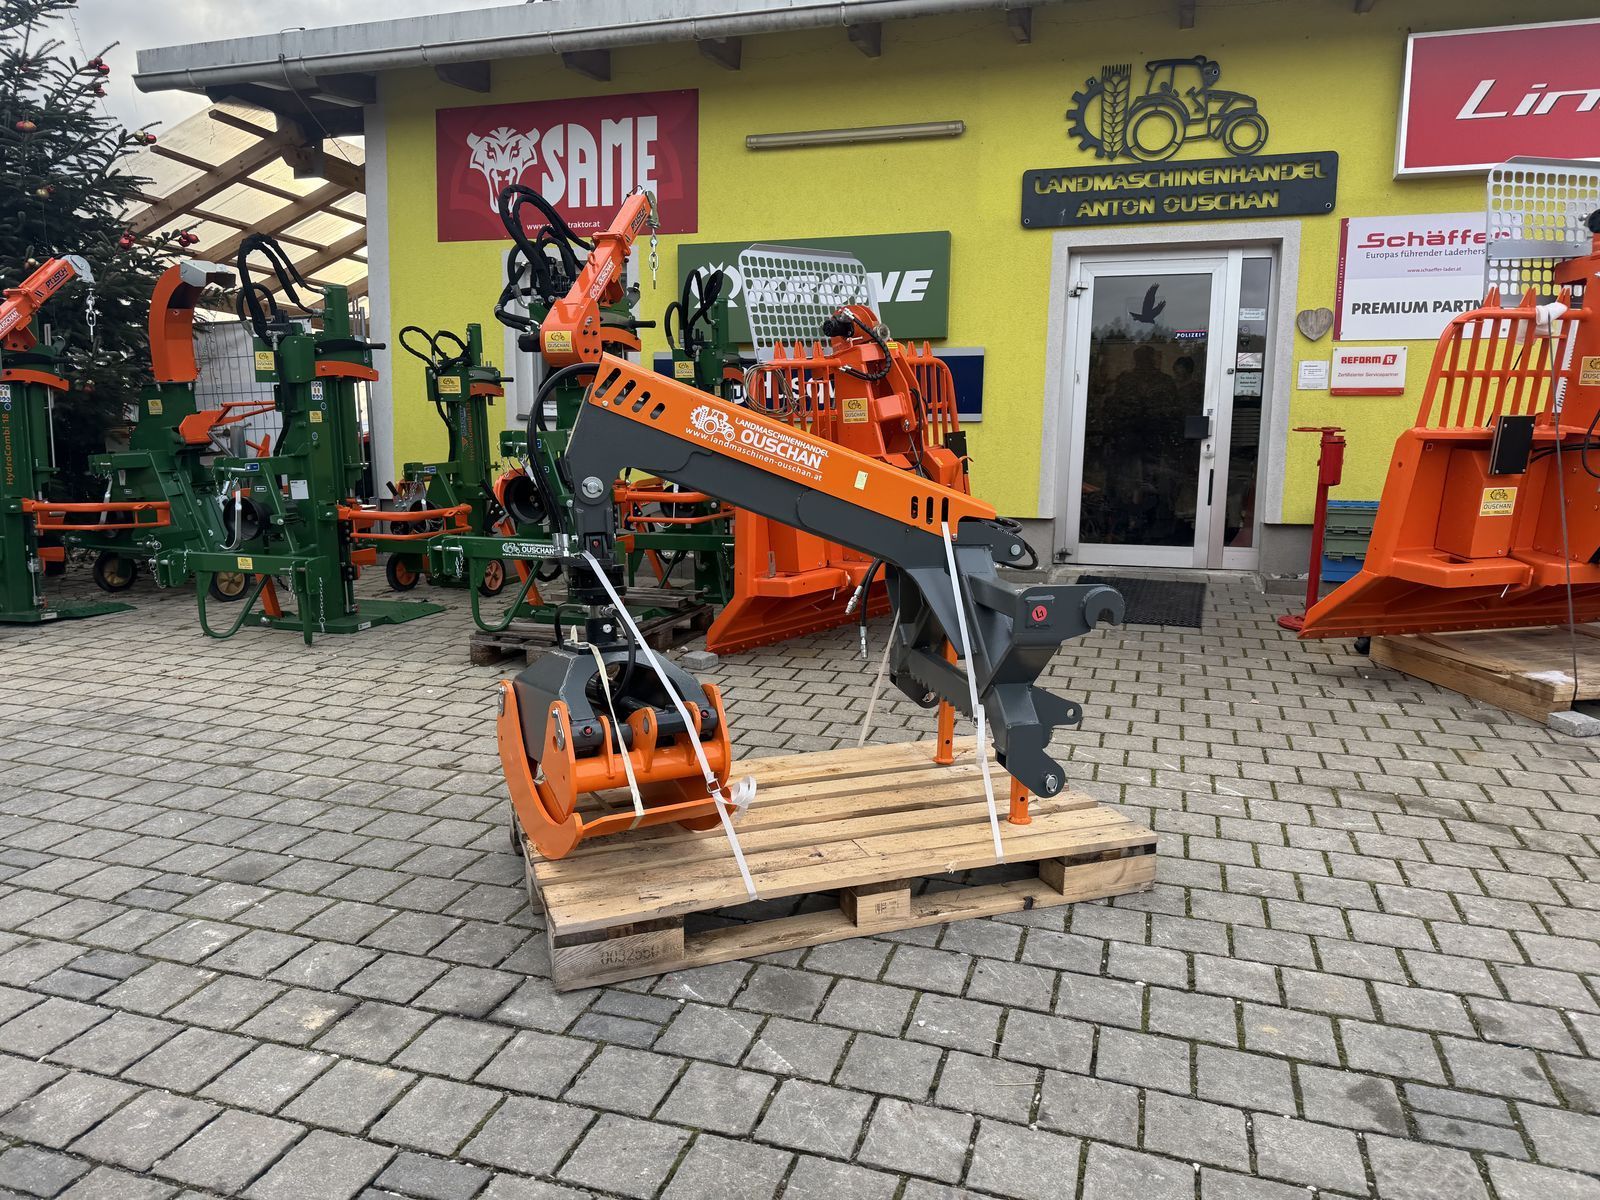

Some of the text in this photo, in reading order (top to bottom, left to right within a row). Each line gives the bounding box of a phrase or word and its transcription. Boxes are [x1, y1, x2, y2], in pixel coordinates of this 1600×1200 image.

[541, 115, 658, 208] SAME
[1034, 159, 1327, 195] LANDMASCHINENHANDEL
[1076, 189, 1280, 217] ANTON OUSCHAN
[1366, 251, 1399, 260] Europas
[1401, 249, 1442, 257] führender
[1351, 300, 1428, 315] PREMIUM
[1341, 356, 1381, 364] REFORM
[2, 426, 15, 485] HydroCombi
[685, 426, 823, 482] www.landmaschinen-ouschan.at
[735, 417, 829, 458] LANDMASCHINENHANDEL
[740, 429, 823, 470] OUSCHAN
[521, 546, 555, 555] OUSCHAN
